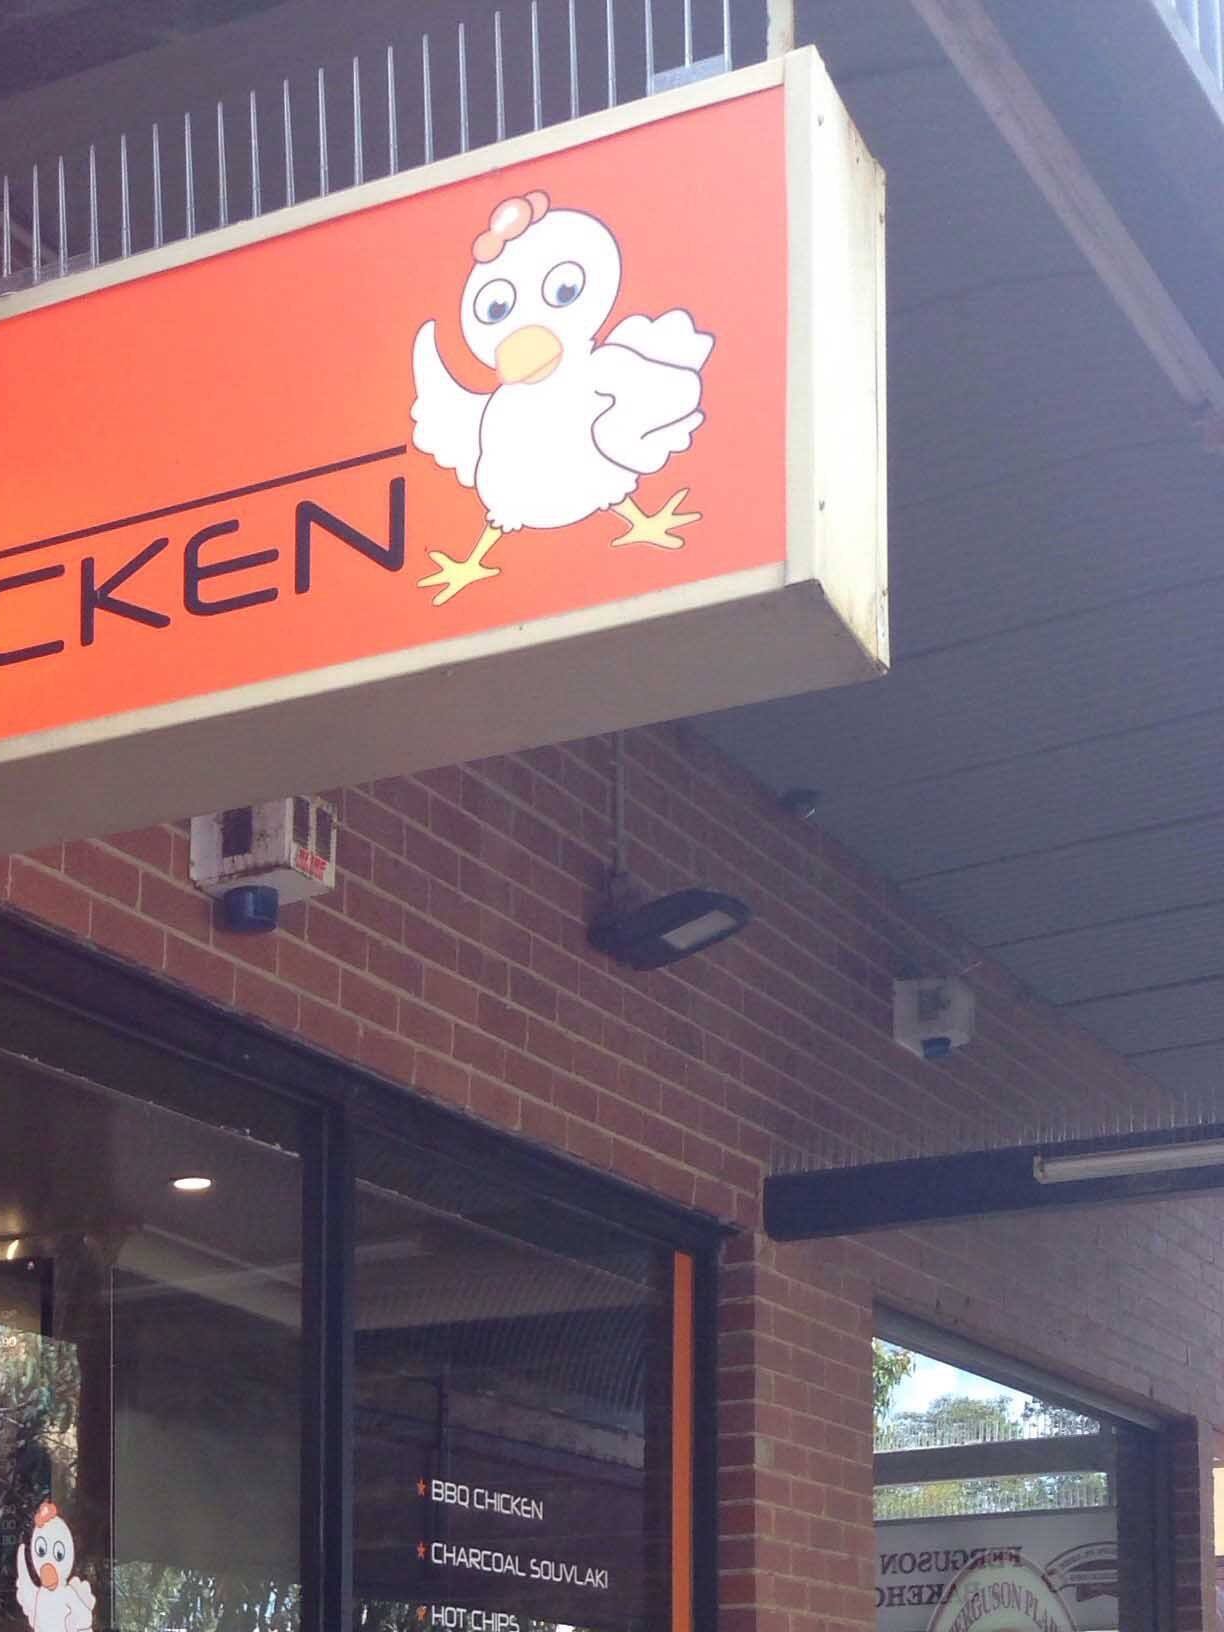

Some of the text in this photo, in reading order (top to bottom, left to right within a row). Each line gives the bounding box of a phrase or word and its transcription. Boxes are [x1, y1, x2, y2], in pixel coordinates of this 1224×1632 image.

[431, 1479, 544, 1521] BBQ CHICKEN
[431, 1542, 608, 1589] CHARCOAL SOUVLAKI
[431, 1605, 467, 1629] HOT
